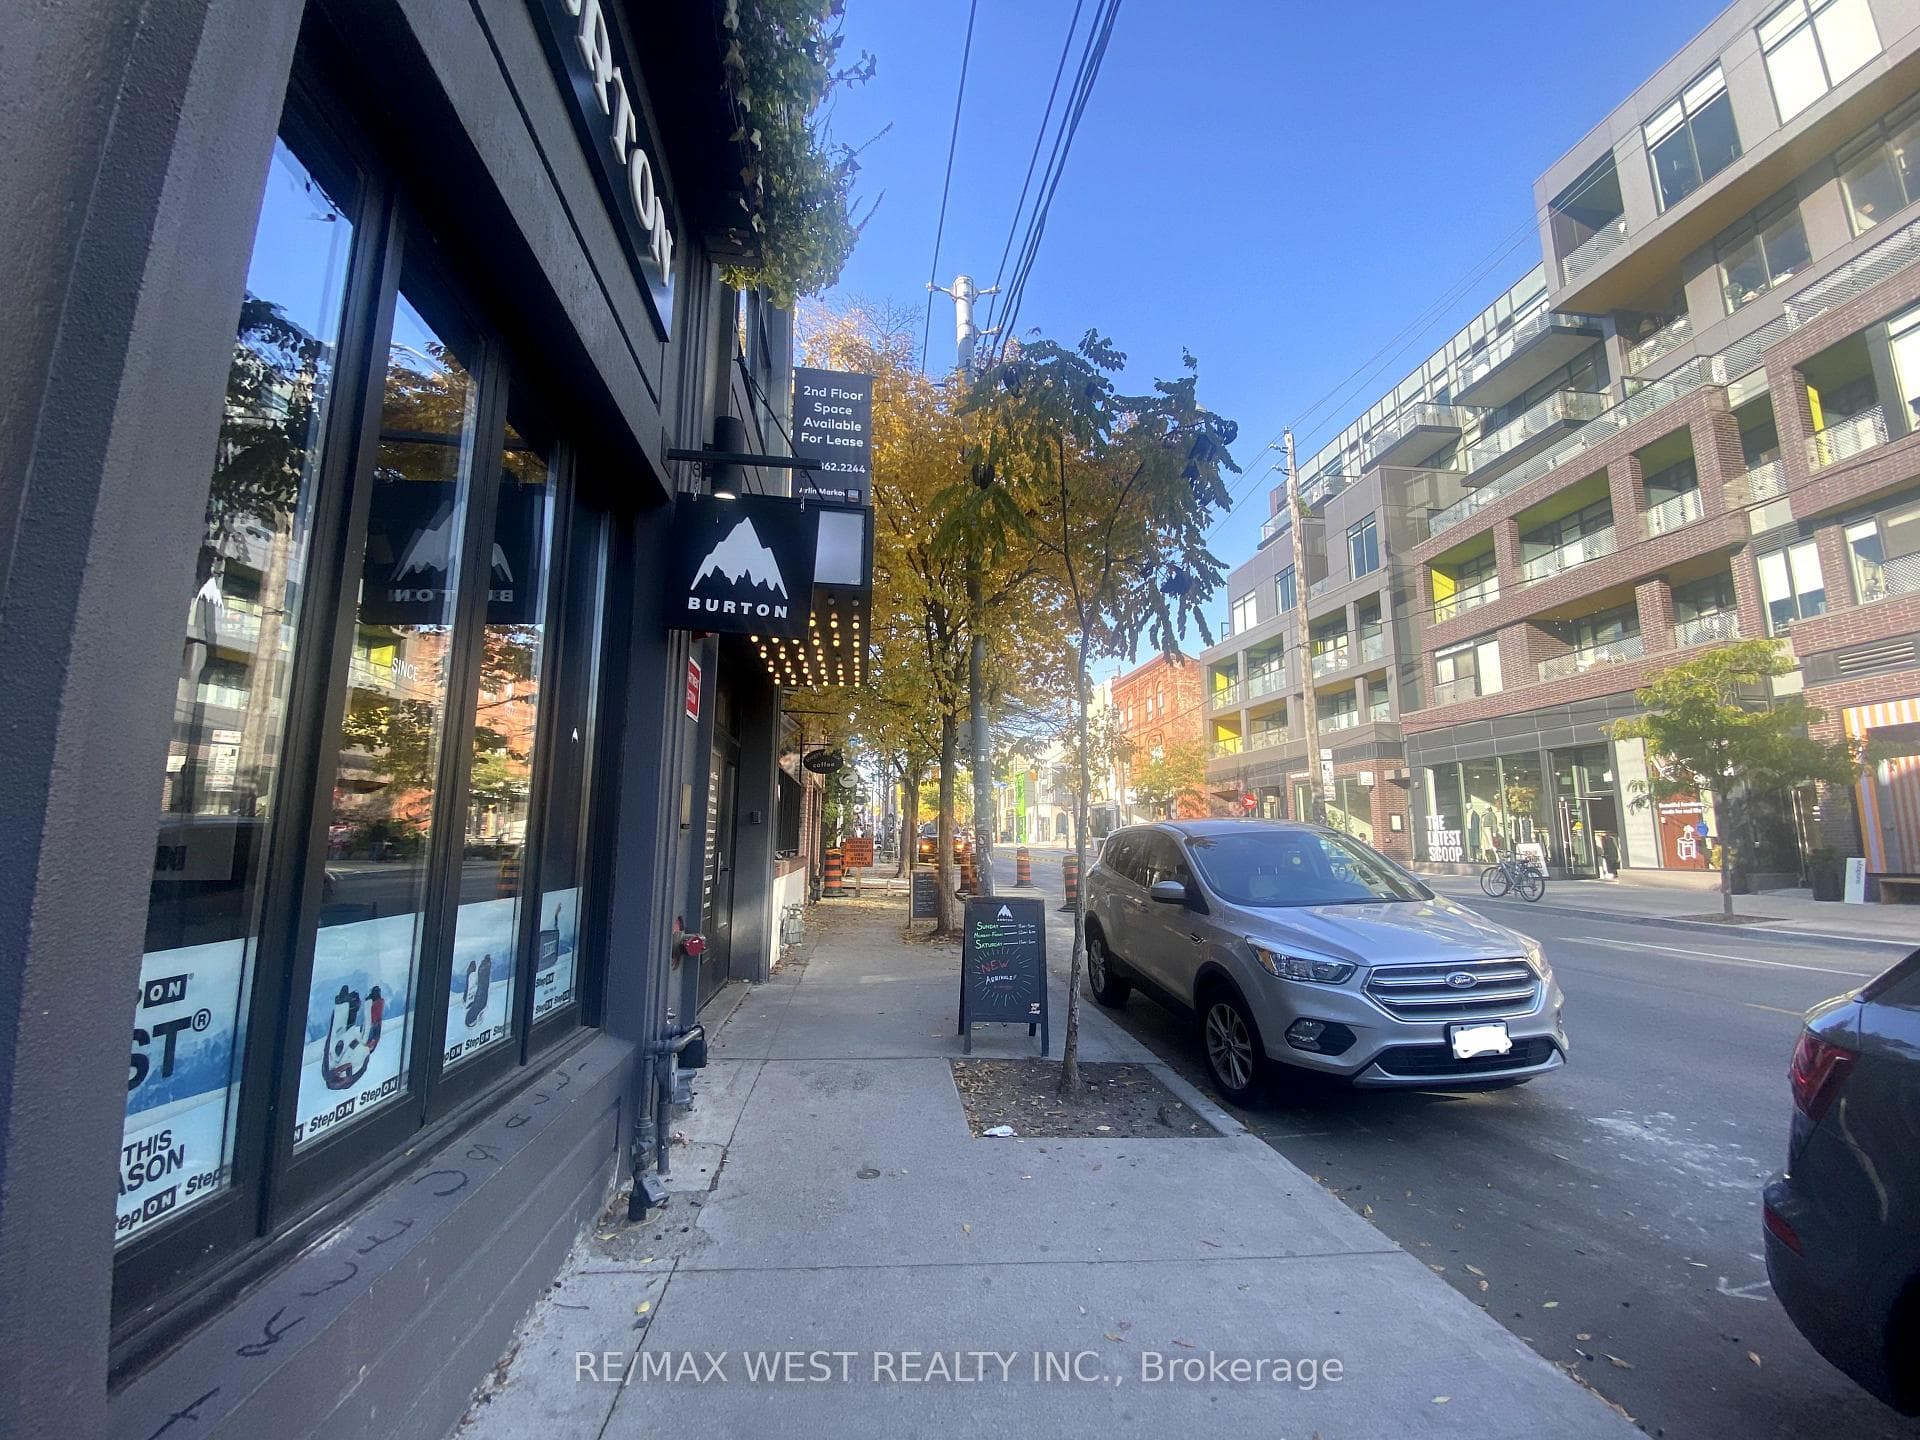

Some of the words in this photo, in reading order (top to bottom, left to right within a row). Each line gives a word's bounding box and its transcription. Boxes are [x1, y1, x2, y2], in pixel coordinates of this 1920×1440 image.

[561, 0, 673, 287] RTON
[803, 385, 827, 397] 2nd
[830, 388, 863, 401] Floor
[814, 402, 853, 416] Space
[803, 417, 862, 432] Available
[801, 432, 823, 444] For
[826, 434, 864, 447] Lease
[687, 597, 788, 618] BURTON
[392, 658, 417, 682] SINCE
[1426, 815, 1446, 830] THE
[1427, 830, 1461, 846] LATEST
[1428, 846, 1463, 862] SCOOP
[1454, 975, 1471, 985] Ford
[123, 1129, 172, 1166] THIS
